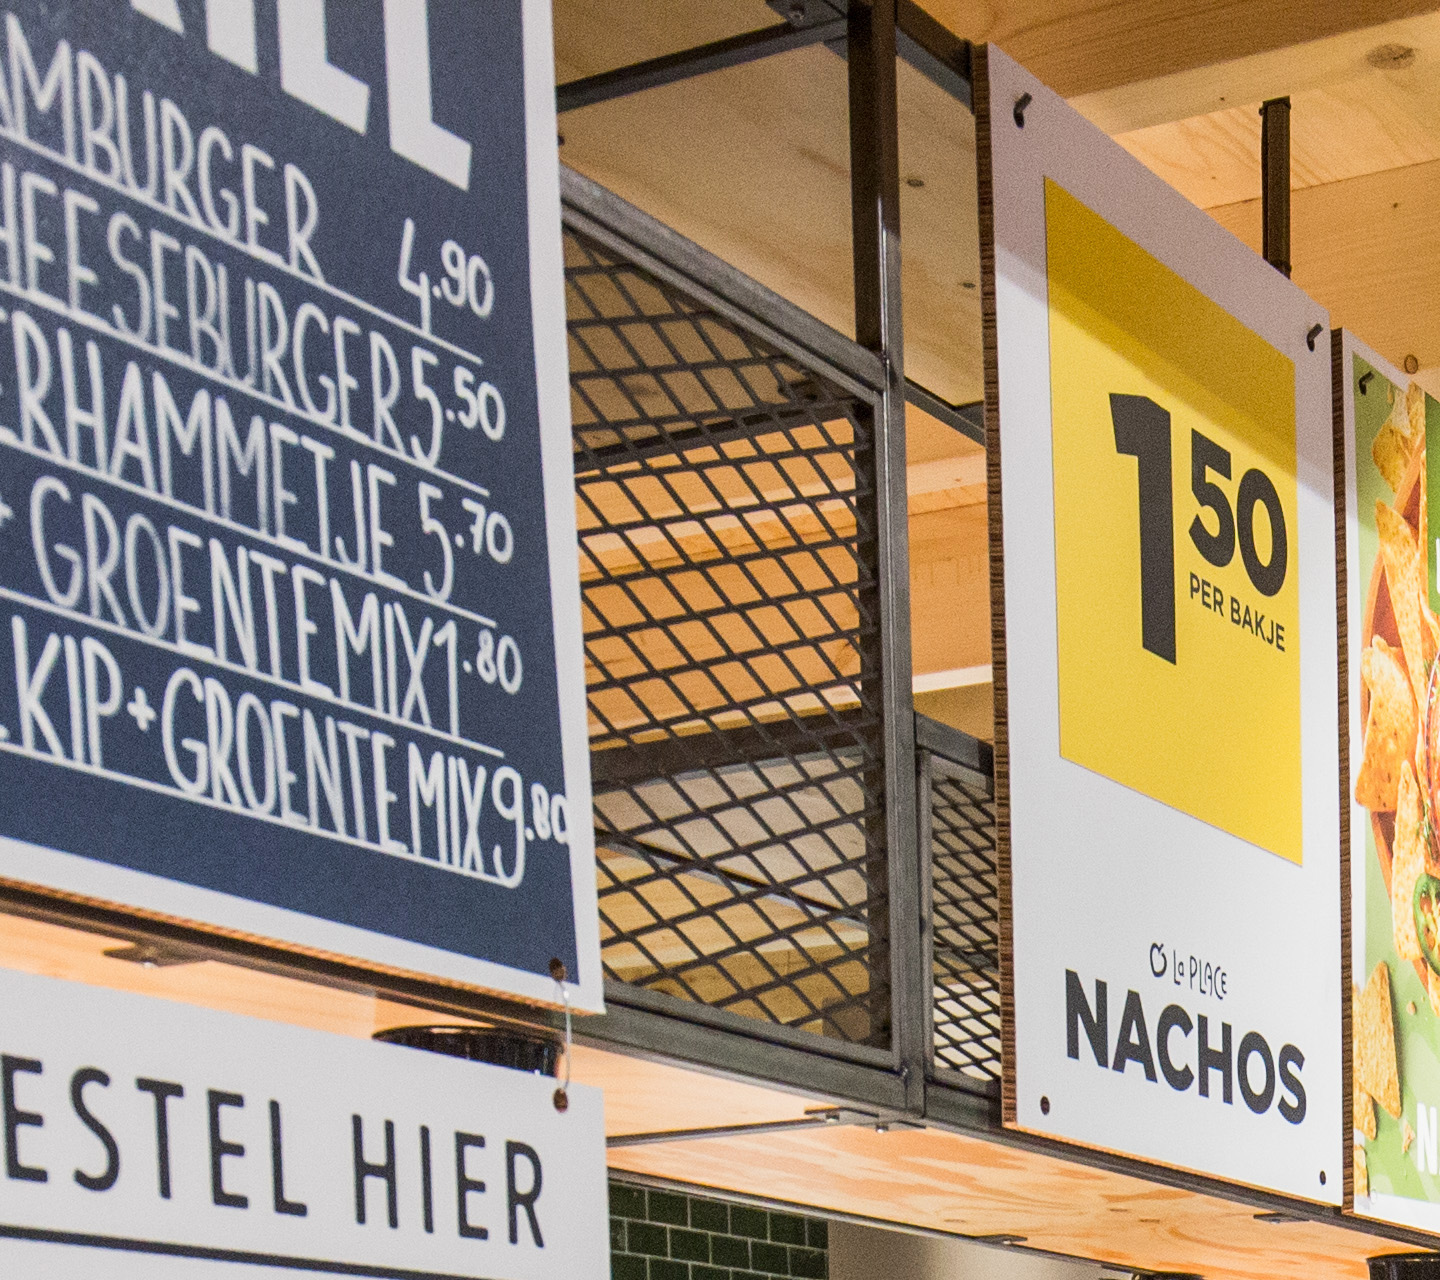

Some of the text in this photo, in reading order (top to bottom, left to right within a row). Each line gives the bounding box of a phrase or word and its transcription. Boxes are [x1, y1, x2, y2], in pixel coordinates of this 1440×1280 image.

[398, 219, 494, 336] 4.90
[414, 346, 505, 469] 5.50
[30, 476, 433, 727] GROENTEMIX
[433, 621, 523, 736] 1.80
[419, 494, 513, 602] 5.70
[1189, 572, 1286, 652] PER BAKJE
[1189, 957, 1228, 1000] PLACE
[1065, 968, 1308, 1125] NACHOS
[352, 1114, 544, 1248] HIER
